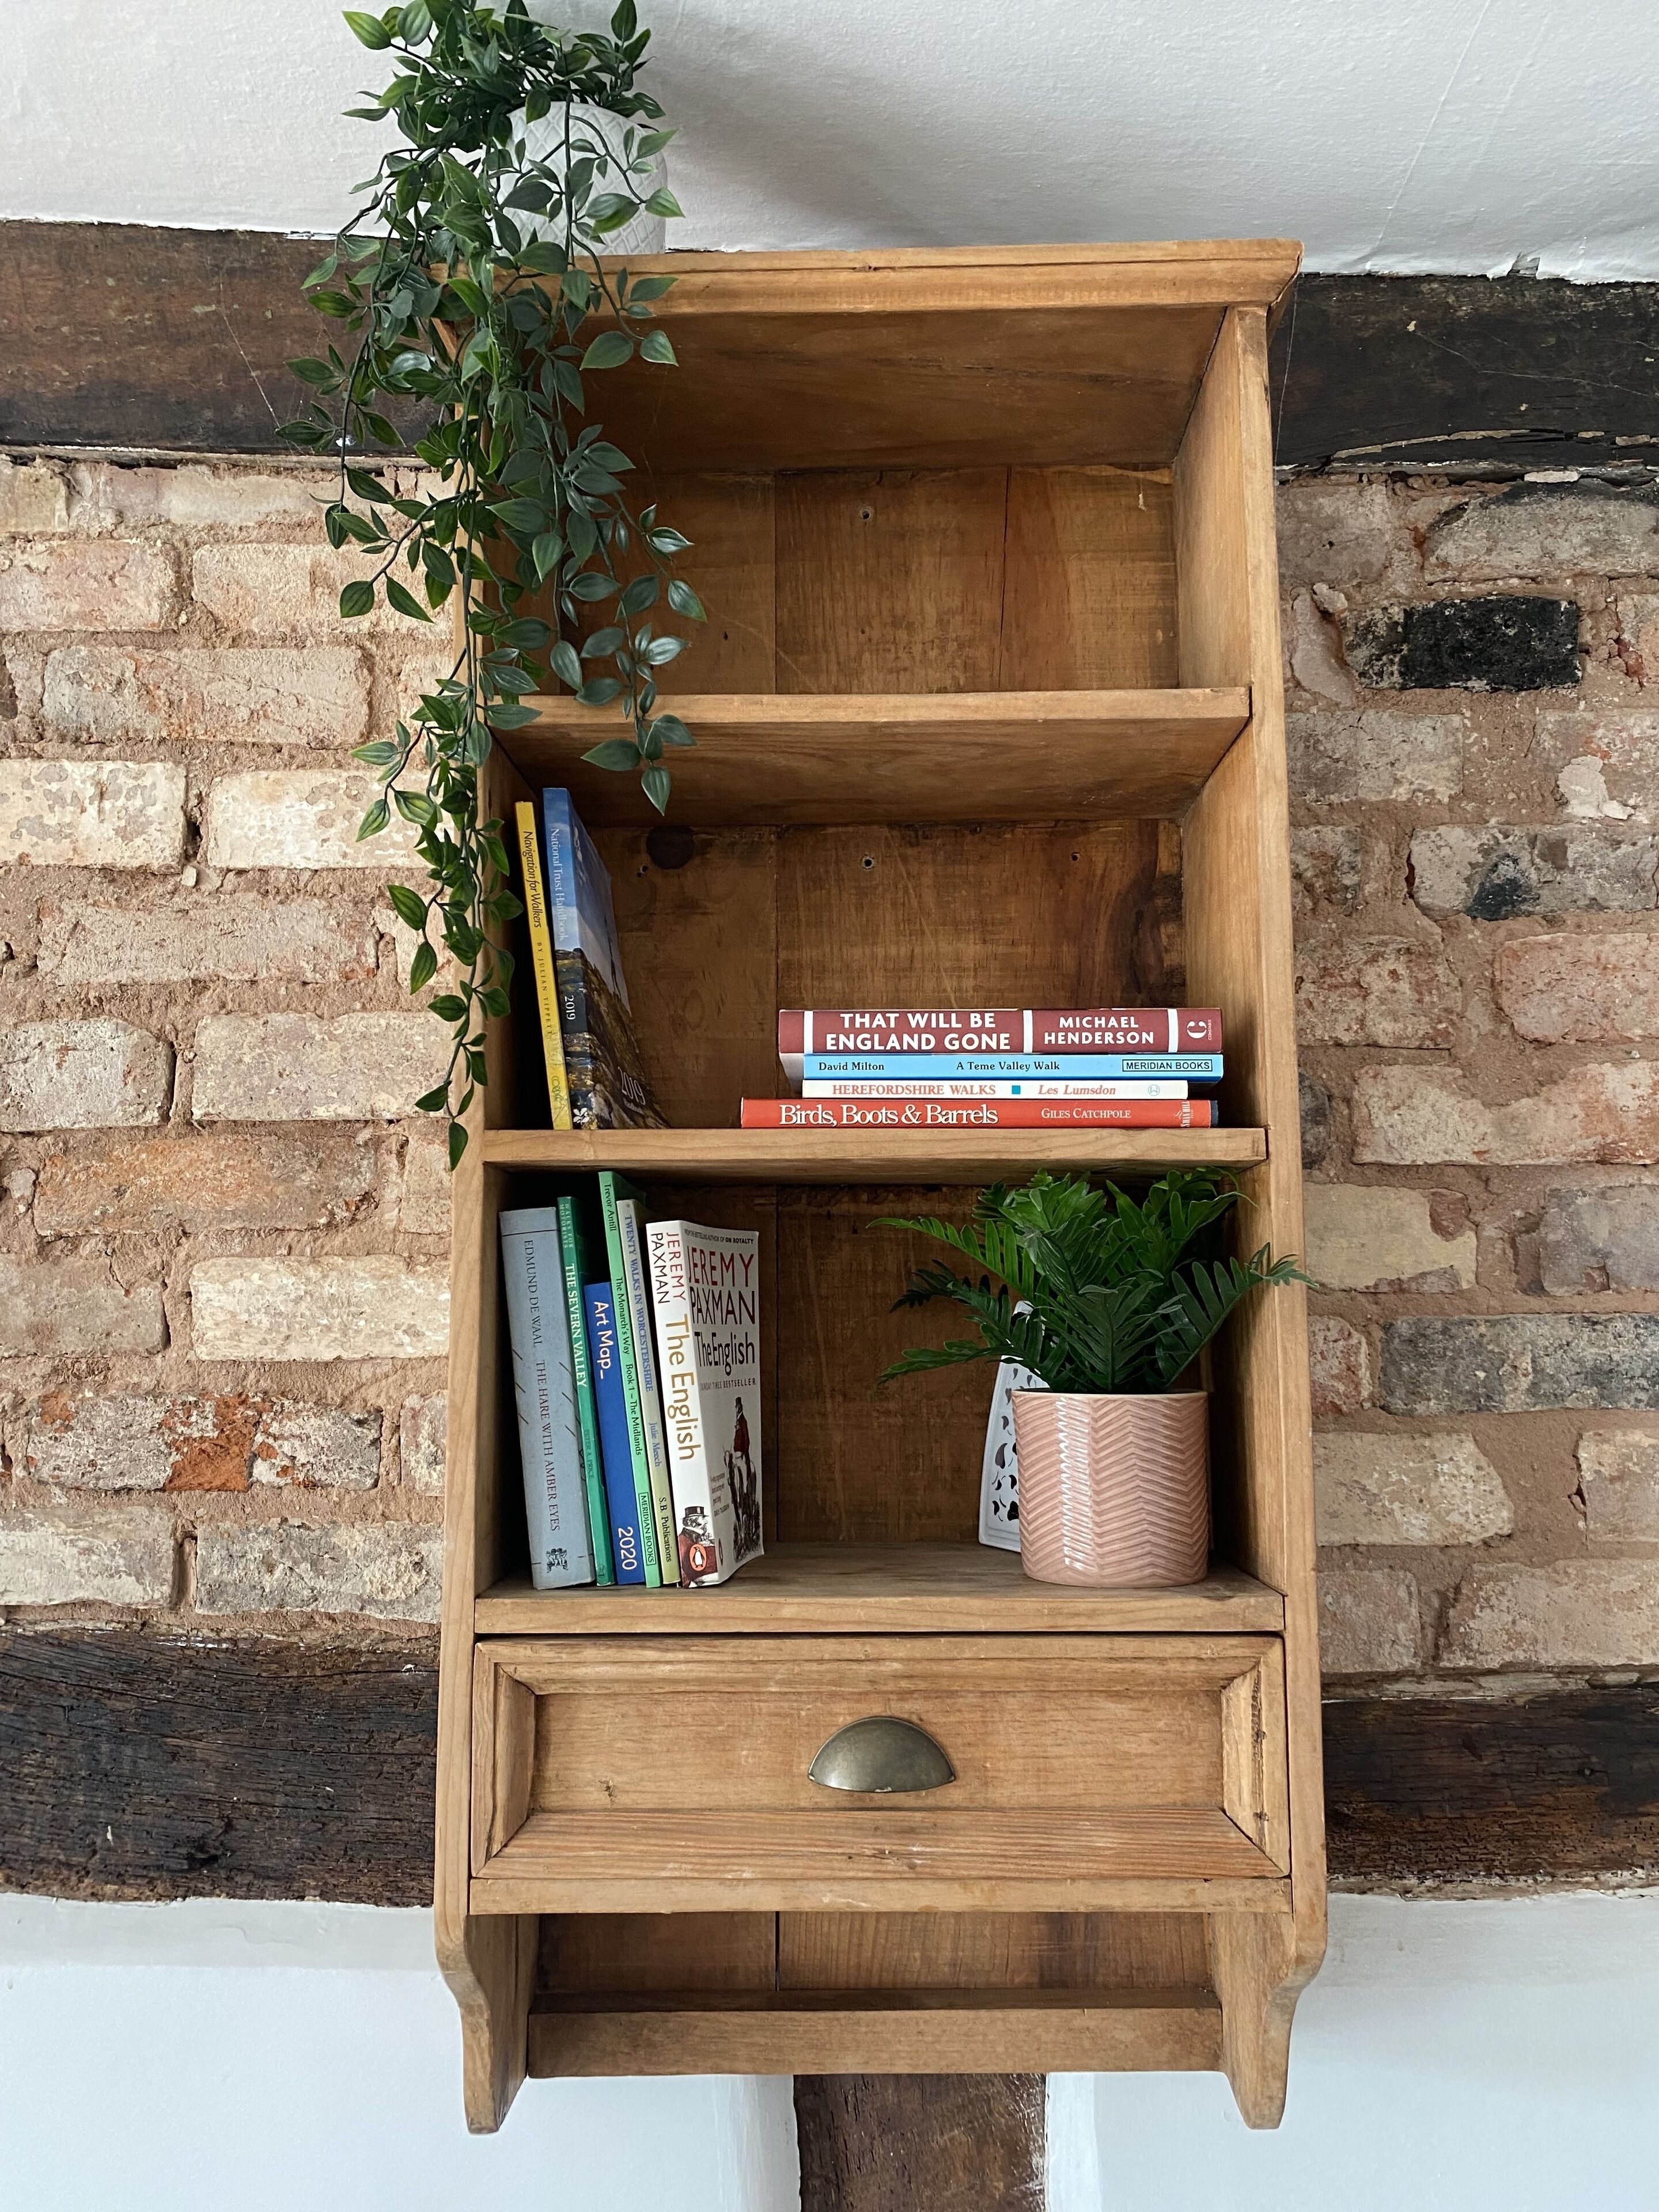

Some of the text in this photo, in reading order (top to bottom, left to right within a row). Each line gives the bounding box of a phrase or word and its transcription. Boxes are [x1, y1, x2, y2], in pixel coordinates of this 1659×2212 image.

[522, 831, 543, 928] Navigation for Walkers
[550, 828, 569, 941] National Trust Handbook
[536, 942, 552, 1035] BY JULIAN TIPPETT
[565, 995, 576, 1020] 2019
[840, 1013, 996, 1028] THAT WILL BE
[1044, 1032, 1154, 1044] HENDERSON
[1059, 1016, 1139, 1028] MICHAEL
[825, 1033, 1011, 1050] ENGLAND GONE
[618, 1066, 646, 1105] 2019
[819, 1061, 885, 1071] David Milton
[956, 1061, 1060, 1070] A Teme Valley Walk
[1126, 1062, 1210, 1070] MERIDIAN BOOKS
[832, 1084, 996, 1095] HEREFORDSHIRE WALKS
[1038, 1085, 1116, 1096] Les Lumsdon
[779, 1103, 999, 1127] Birds, Boots & Barrels
[1041, 1108, 1132, 1119] GILES CATCHPOLE
[559, 1204, 568, 1249] MOTORISTS
[604, 1183, 617, 1232] Trevor Antill
[651, 1233, 671, 1304] PAXMAN
[666, 1232, 686, 1301] JEREMY
[687, 1245, 755, 1287] JEREMY
[524, 1240, 542, 1347] EDMUND DE WAAL
[593, 1301, 609, 1327] Art
[624, 1214, 653, 1392] TWENTY WALKS IN WORCESTERSHIRE
[689, 1286, 756, 1325] PAXMAN
[566, 1263, 588, 1388] THE SEVERN VALLEY
[617, 1293, 629, 1335] Monarch's
[623, 1336, 631, 1355] Way
[626, 1363, 635, 1384] Book
[694, 1331, 755, 1376] The English
[666, 1313, 702, 1460] The English
[723, 1378, 756, 1388] BESTSELLER
[630, 1400, 638, 1415] The
[536, 1359, 560, 1532] THE HARE WITH AMBER EYES
[631, 1416, 643, 1456] Midlands
[649, 1422, 662, 1467] Julie Meech
[618, 1527, 638, 1570] 2020
[640, 1495, 655, 1563] MERIDIAN BOOKS
[659, 1497, 673, 1562] S.B. Publications
